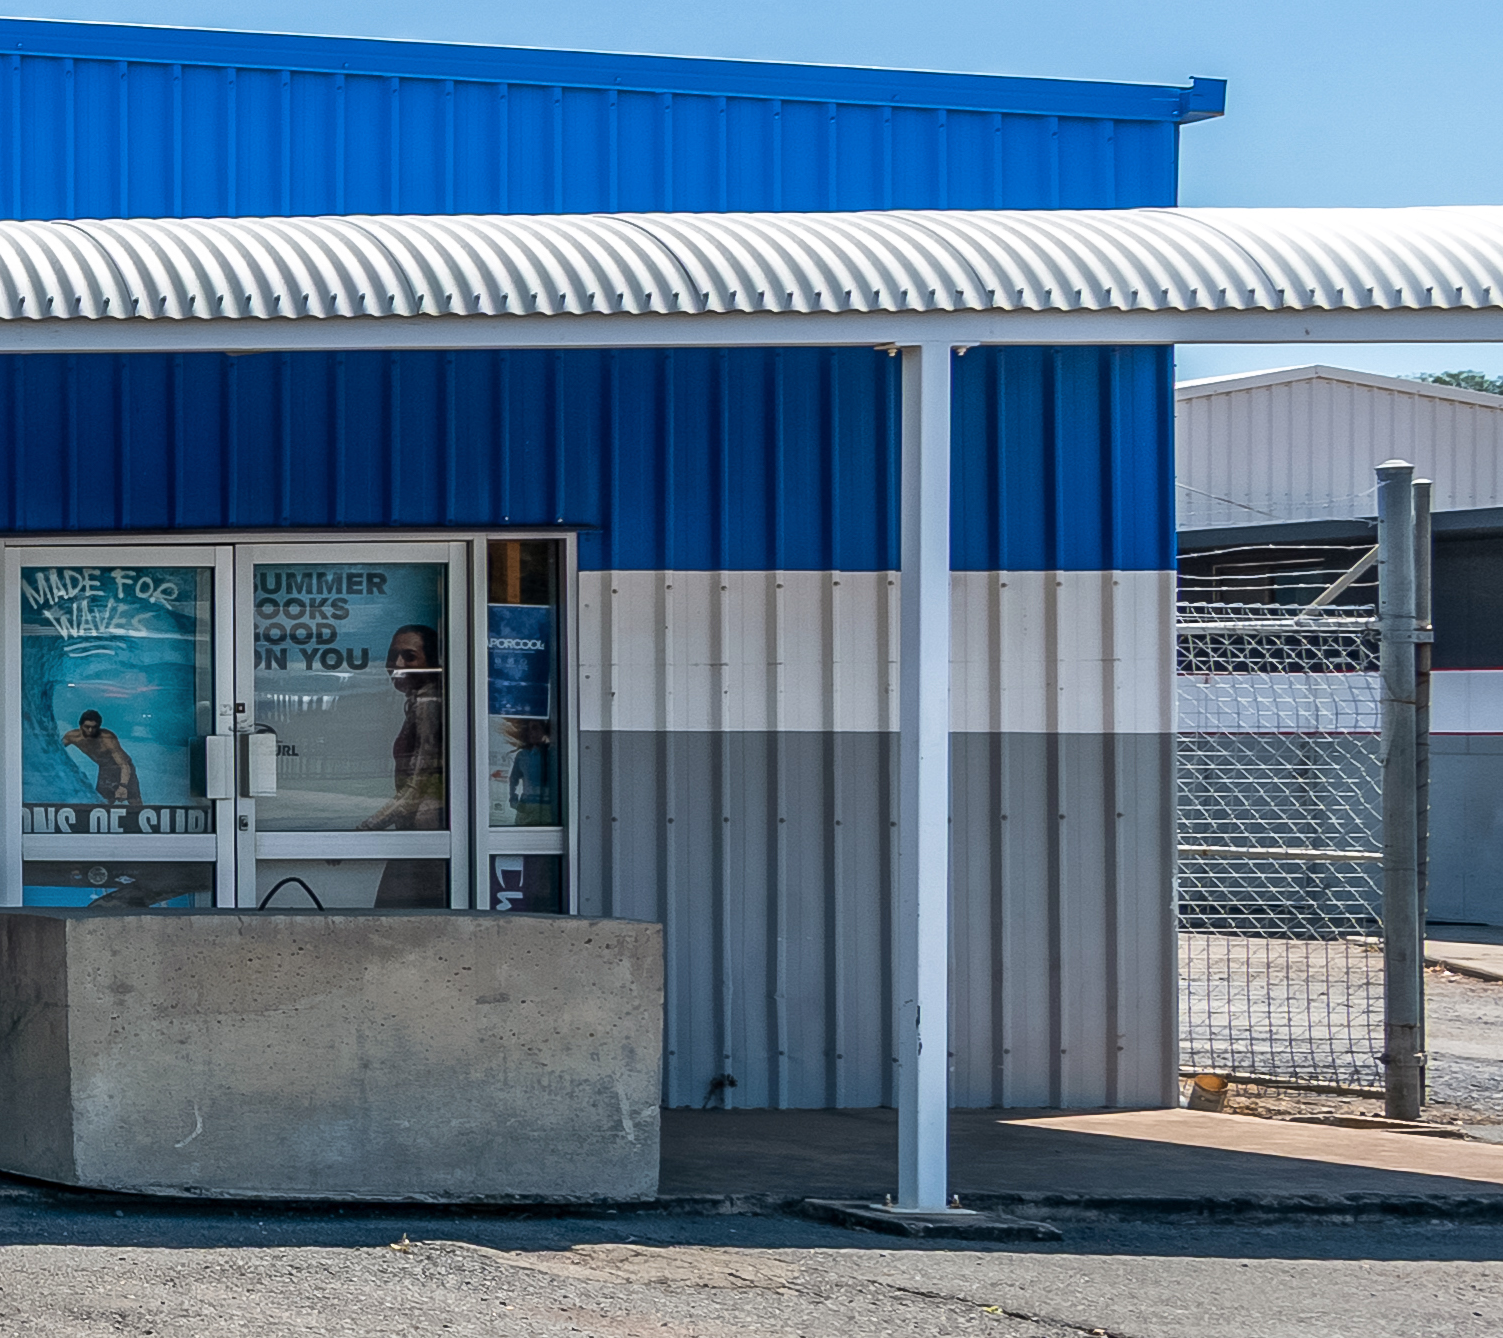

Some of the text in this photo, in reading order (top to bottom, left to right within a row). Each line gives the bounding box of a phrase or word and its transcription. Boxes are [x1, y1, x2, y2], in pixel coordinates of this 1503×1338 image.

[22, 568, 180, 610] MADE FOR
[42, 597, 159, 641] WAVES
[256, 597, 350, 621] OOKS
[299, 647, 370, 671] YOU
